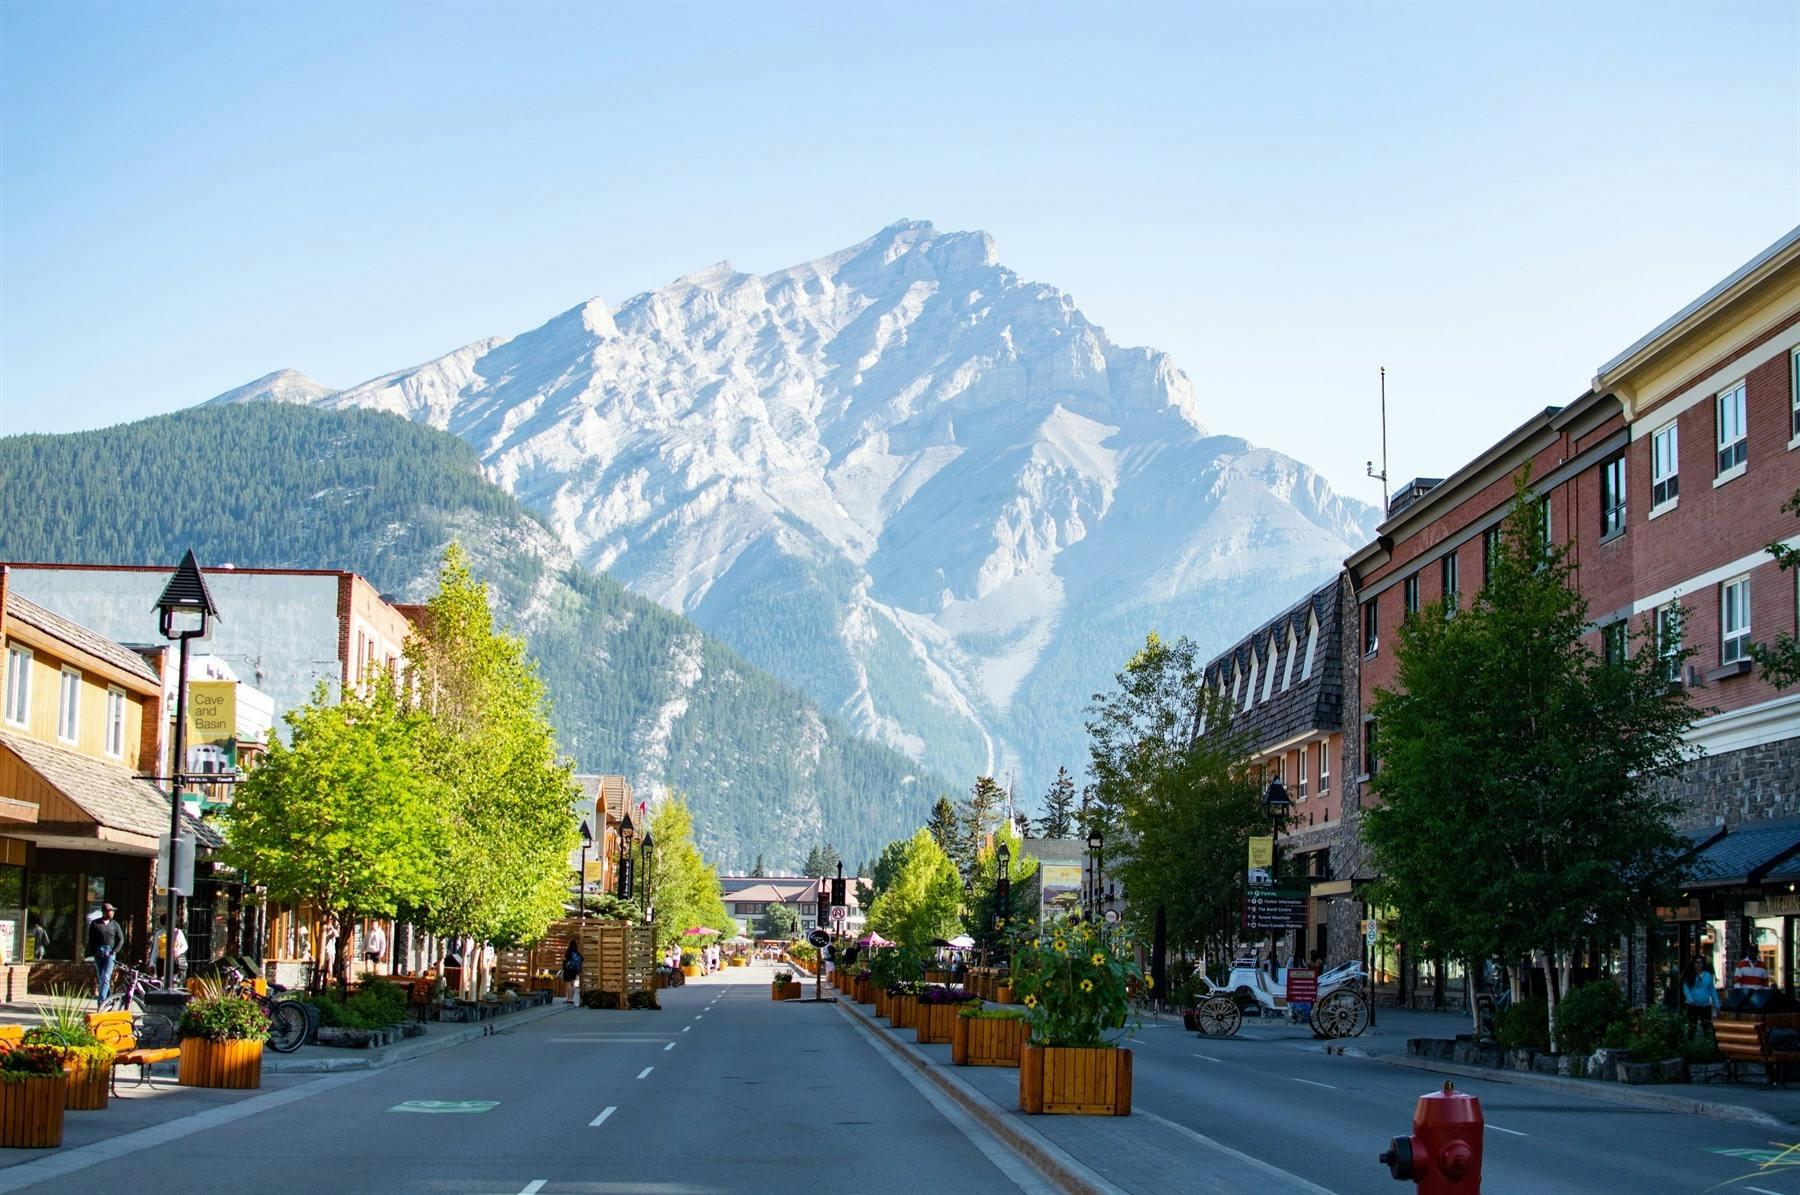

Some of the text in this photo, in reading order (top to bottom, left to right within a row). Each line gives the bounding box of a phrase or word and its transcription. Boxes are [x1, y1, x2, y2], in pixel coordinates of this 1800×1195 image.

[194, 694, 224, 705] Cave
[195, 706, 217, 717] and
[195, 718, 227, 730] Basin
